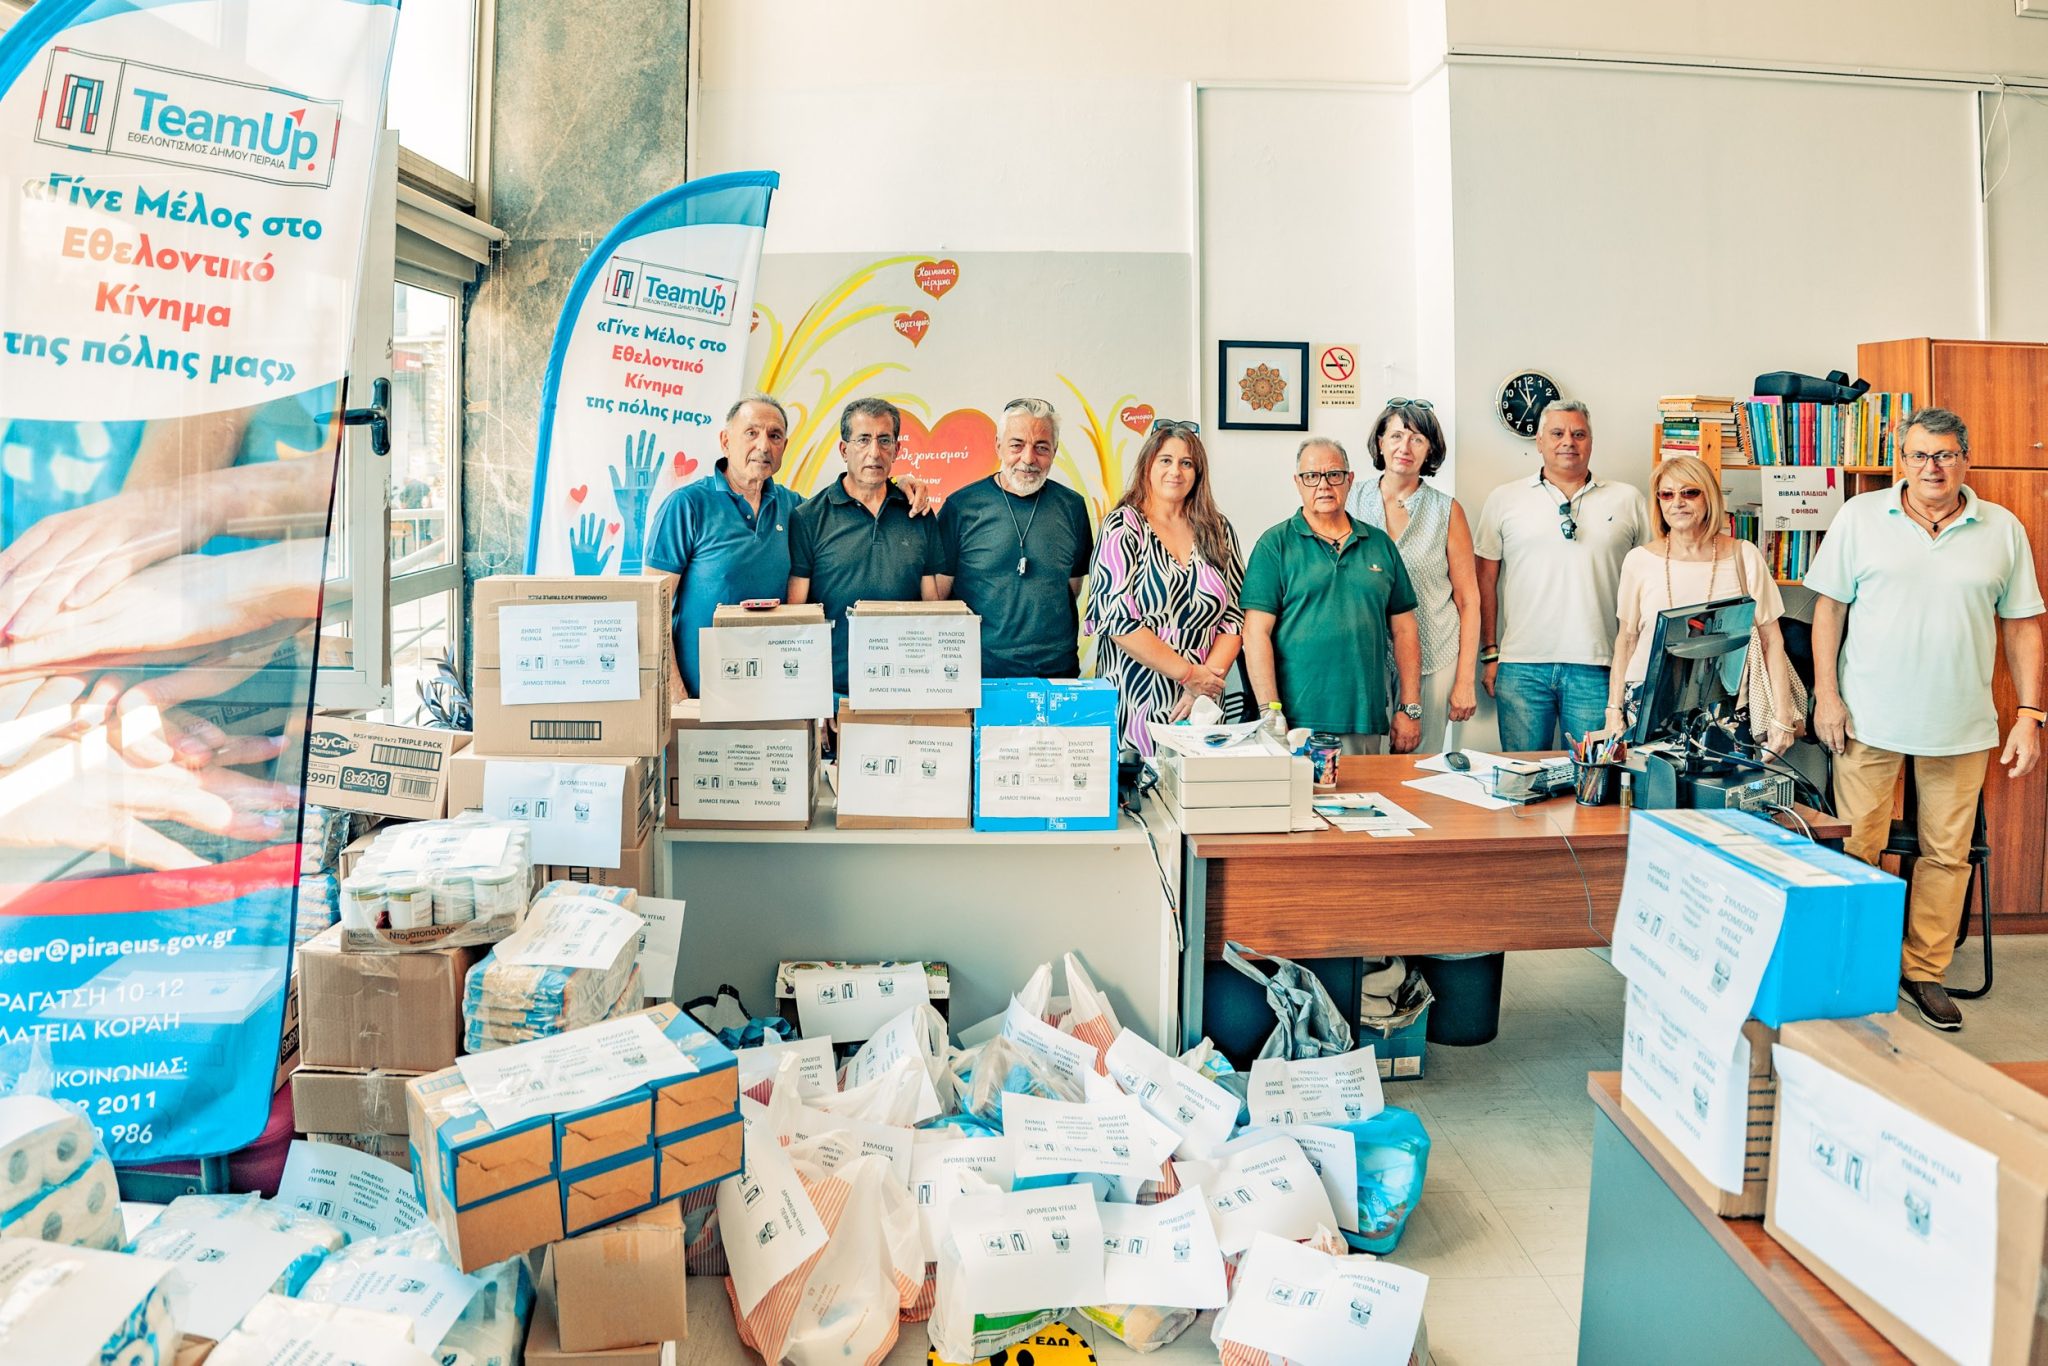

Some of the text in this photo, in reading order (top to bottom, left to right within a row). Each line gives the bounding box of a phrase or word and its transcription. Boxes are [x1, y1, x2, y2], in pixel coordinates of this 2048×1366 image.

[128, 132, 285, 169] ΕΘΕΛΟΝΤΙΣΜΟΣ ΔΗΜΟΥ ΠΕΙΡΑΙΑ
[21, 172, 322, 241] «Γίνε Μέλος στο
[62, 227, 274, 282] Εθελοντικό
[95, 281, 231, 332] Κίνημα
[597, 317, 726, 352] «Γίνε Μέλος στο
[4, 331, 296, 386] της πόλης μας»
[612, 345, 703, 373] Εθελοντικό
[625, 373, 683, 397] Κίνημα
[586, 396, 712, 425] της πόλης μας»
[896, 447, 969, 469] θελοντισμού
[309, 734, 359, 751] abyCare
[398, 737, 422, 746] TRIPLE
[423, 741, 442, 749] PACK
[344, 769, 387, 788] 8x216
[0, 928, 236, 965] eer@piraeus.gov.gr
[0, 978, 184, 1013] ΡΑΓΑΤΣΗ 10-12
[0, 1011, 180, 1045] ΛΑΤΕΙΑ ΚΟΡΑΗ
[50, 1056, 188, 1090] ΙΚΟΙΝΩΝΙΑΣ:
[98, 1091, 156, 1115] 2011
[111, 1123, 153, 1144] 986
[863, 1141, 893, 1152] ΣΥΛΛΟΓΟΣ
[308, 1176, 335, 1186] ΠΕΙΡΑΙΑ
[311, 1168, 337, 1177] ΔΗΜΟΣ
[395, 1197, 424, 1218] ΔΡΟΜΕΩΝ
[399, 1209, 416, 1224] ΥΓΕΙΑΣ
[1026, 1207, 1058, 1216] ΔΡΟΜΕΩΝ
[352, 1215, 376, 1231] TeamUp
[1353, 1282, 1381, 1295] ΠΕΙΡΑΙΑ
[1376, 1279, 1400, 1293] ΥΓΕΙΑΣ
[1036, 1336, 1069, 1346] ΕΔΩ
